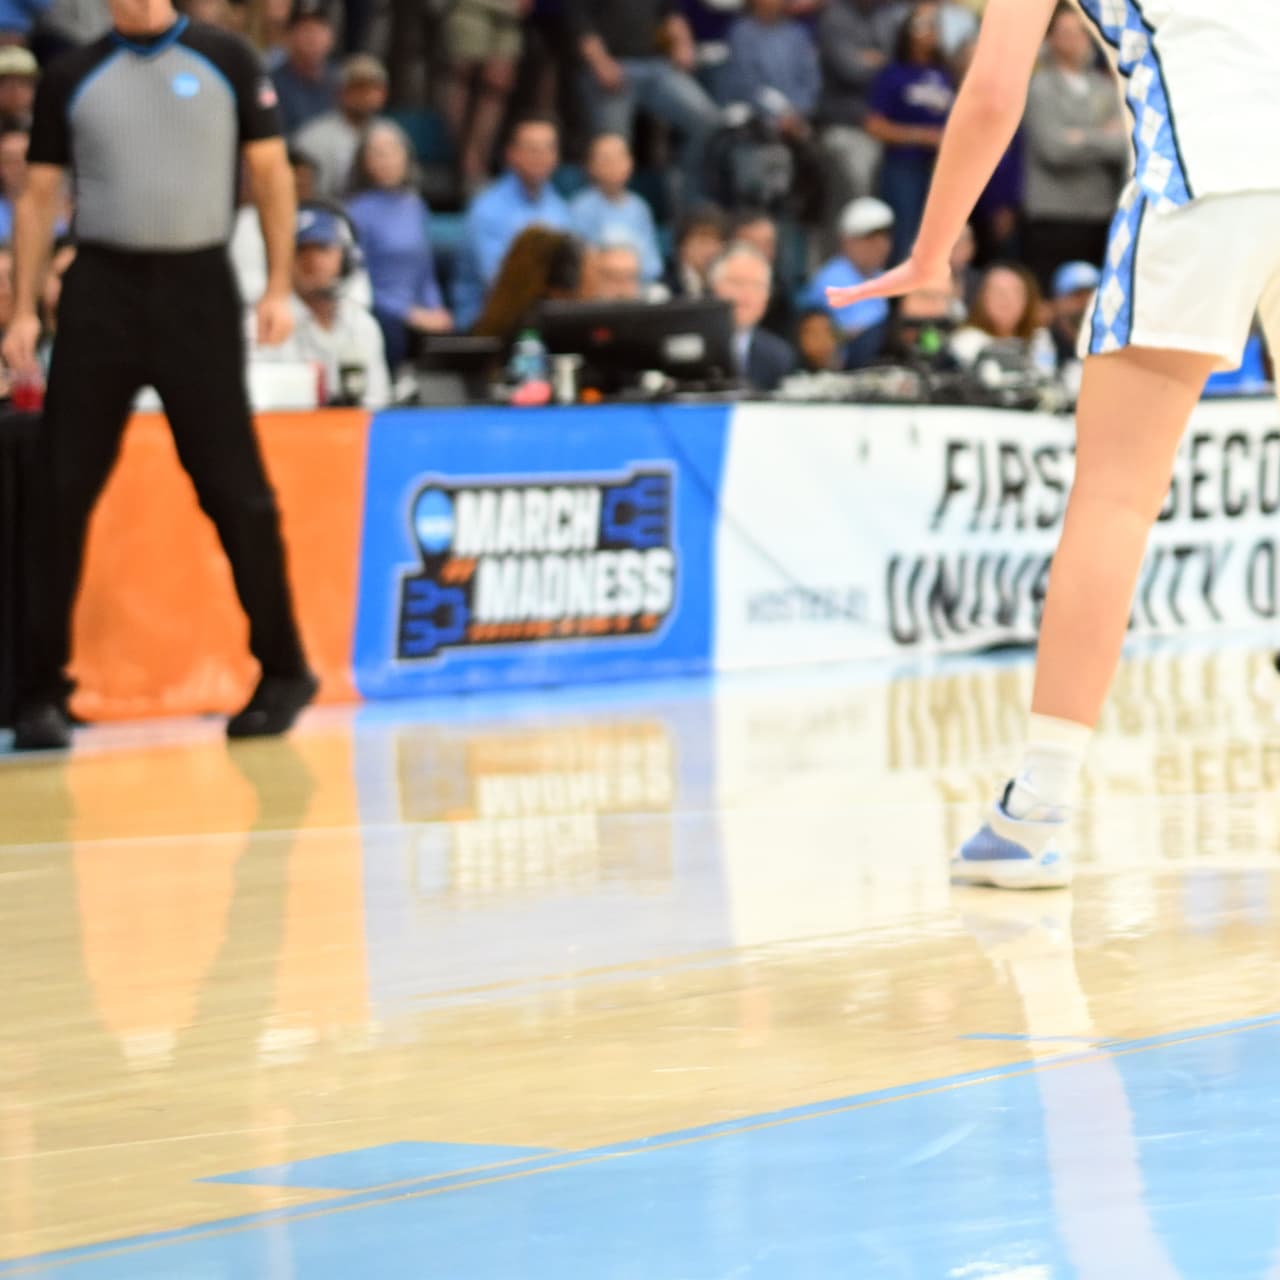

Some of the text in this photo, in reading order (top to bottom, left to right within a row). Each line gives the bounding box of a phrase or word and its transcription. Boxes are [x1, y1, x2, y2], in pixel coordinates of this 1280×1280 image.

[453, 485, 602, 556] MARCH
[929, 438, 1075, 532] FIRS
[472, 547, 675, 626] MADNESS
